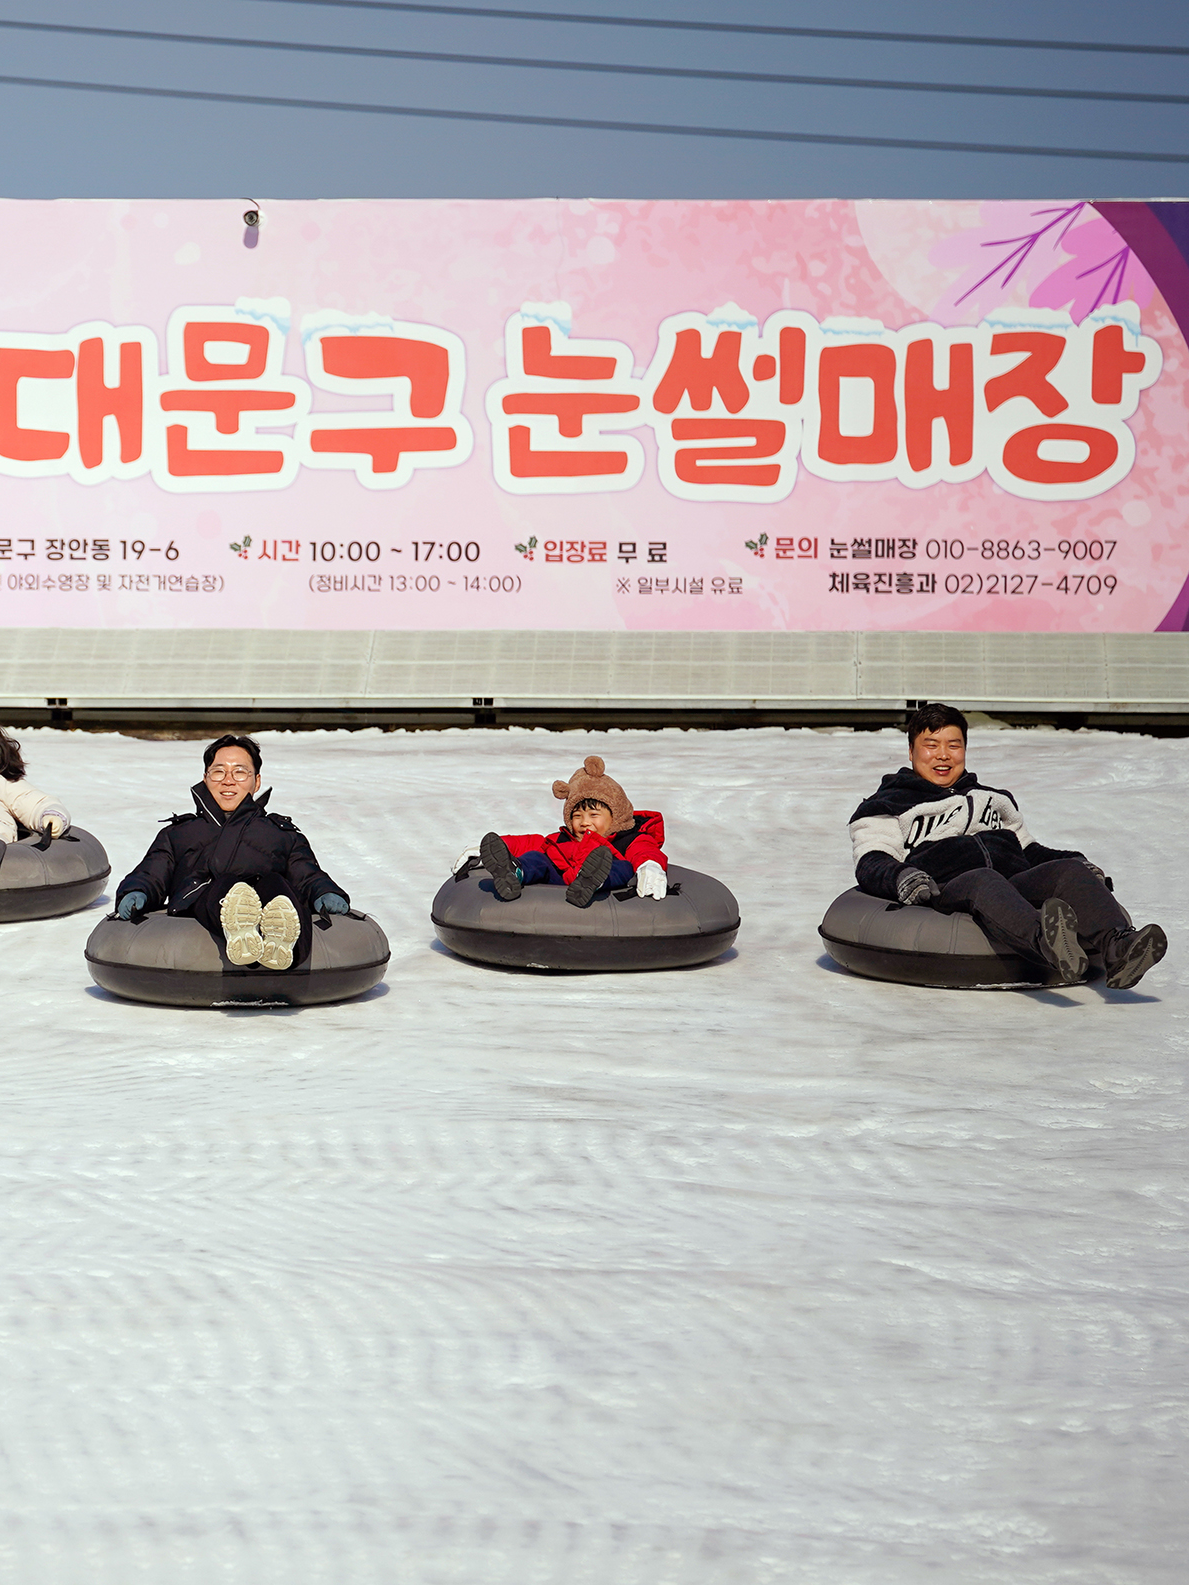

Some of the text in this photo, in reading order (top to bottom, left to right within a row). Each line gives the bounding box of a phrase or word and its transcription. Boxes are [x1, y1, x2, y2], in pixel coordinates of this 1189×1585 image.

[501, 323, 1146, 487] 눈썰매장
[45, 538, 110, 561] 장안동
[119, 540, 180, 561] 19-6
[258, 539, 301, 562] 시간
[309, 541, 381, 562] 10:00
[411, 541, 480, 562] 17:00
[544, 540, 607, 564] 입장료
[774, 537, 1117, 561] 문의 눈썰매장 010-8863-9007
[7, 573, 90, 592] 야외수영장
[96, 573, 112, 592] 및
[118, 573, 225, 593] 자전거연습장)
[309, 574, 382, 593] (정비시간
[389, 575, 441, 593] 13:00
[463, 574, 522, 594] 14:00)
[637, 576, 704, 595] 일부시설
[710, 576, 744, 595] 유료
[828, 572, 1118, 596] 체육진흥과 02)2127-4709
